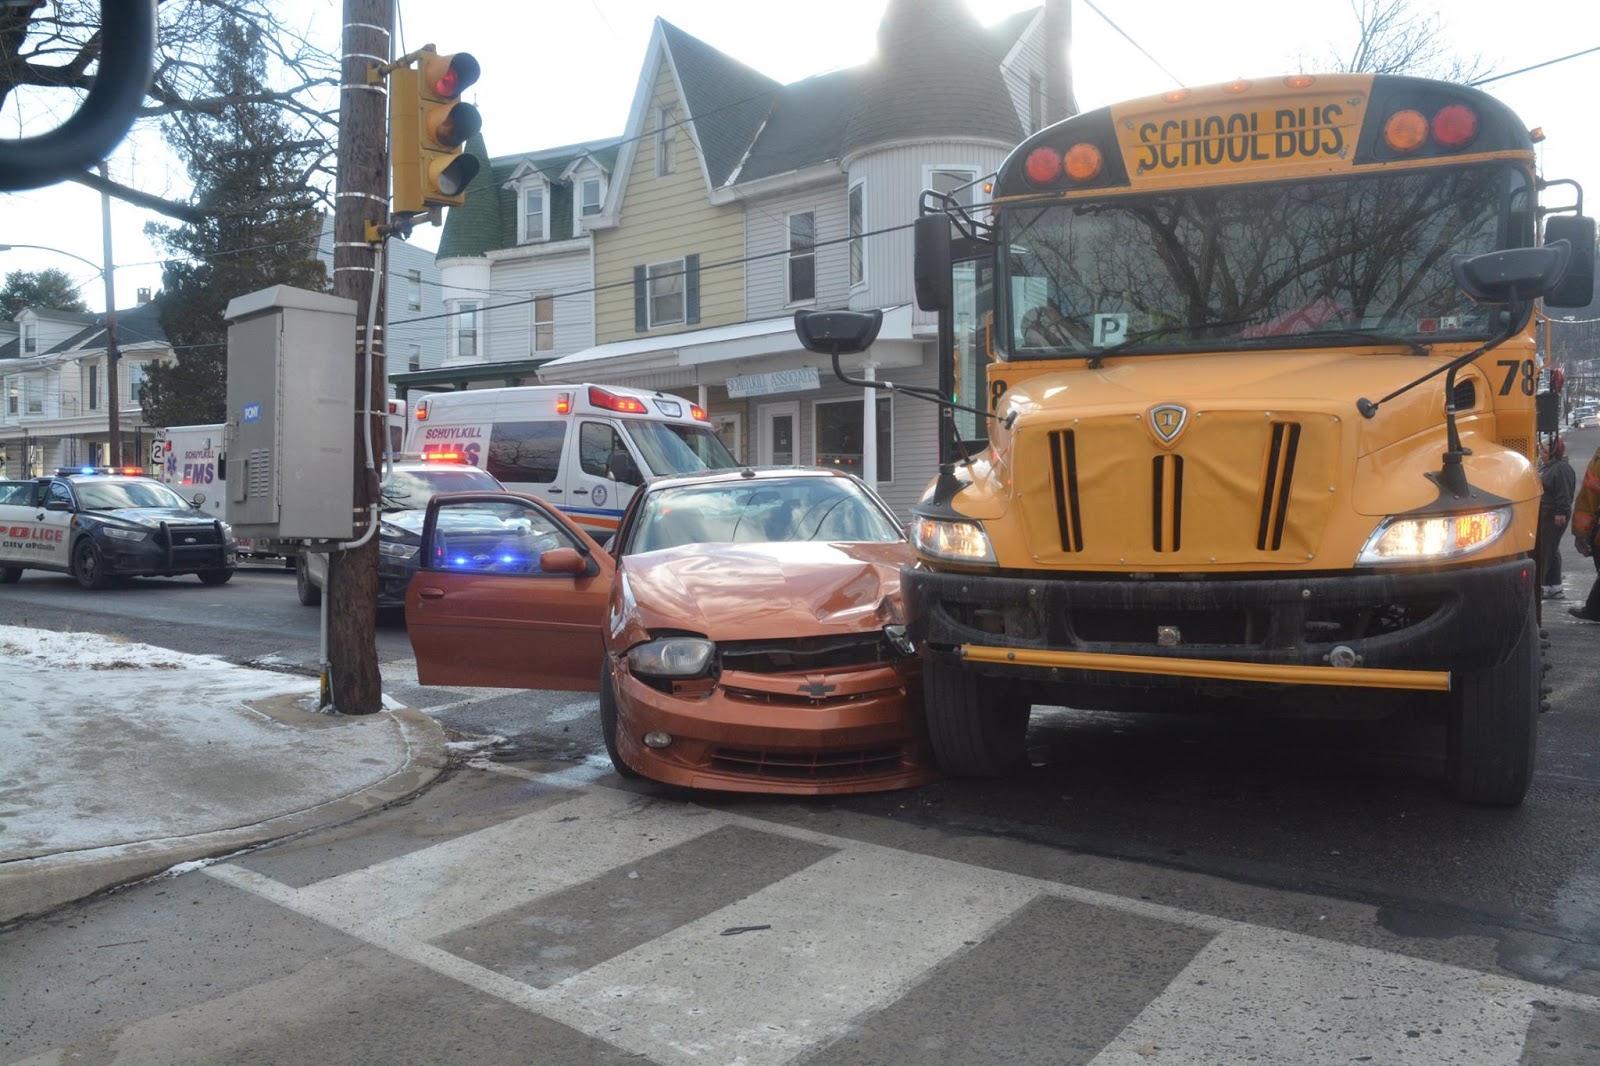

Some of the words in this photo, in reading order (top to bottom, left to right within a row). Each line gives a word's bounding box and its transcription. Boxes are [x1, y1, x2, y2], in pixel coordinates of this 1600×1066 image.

[1139, 112, 1269, 171] SCHOOL
[1275, 104, 1344, 158] BUS
[1100, 317, 1120, 343] P
[1497, 359, 1535, 396] 78
[989, 379, 1008, 411] 8
[425, 427, 482, 439] SCHUYLKILL
[184, 450, 214, 459] SCHUYLKILL
[183, 462, 214, 485] EMS
